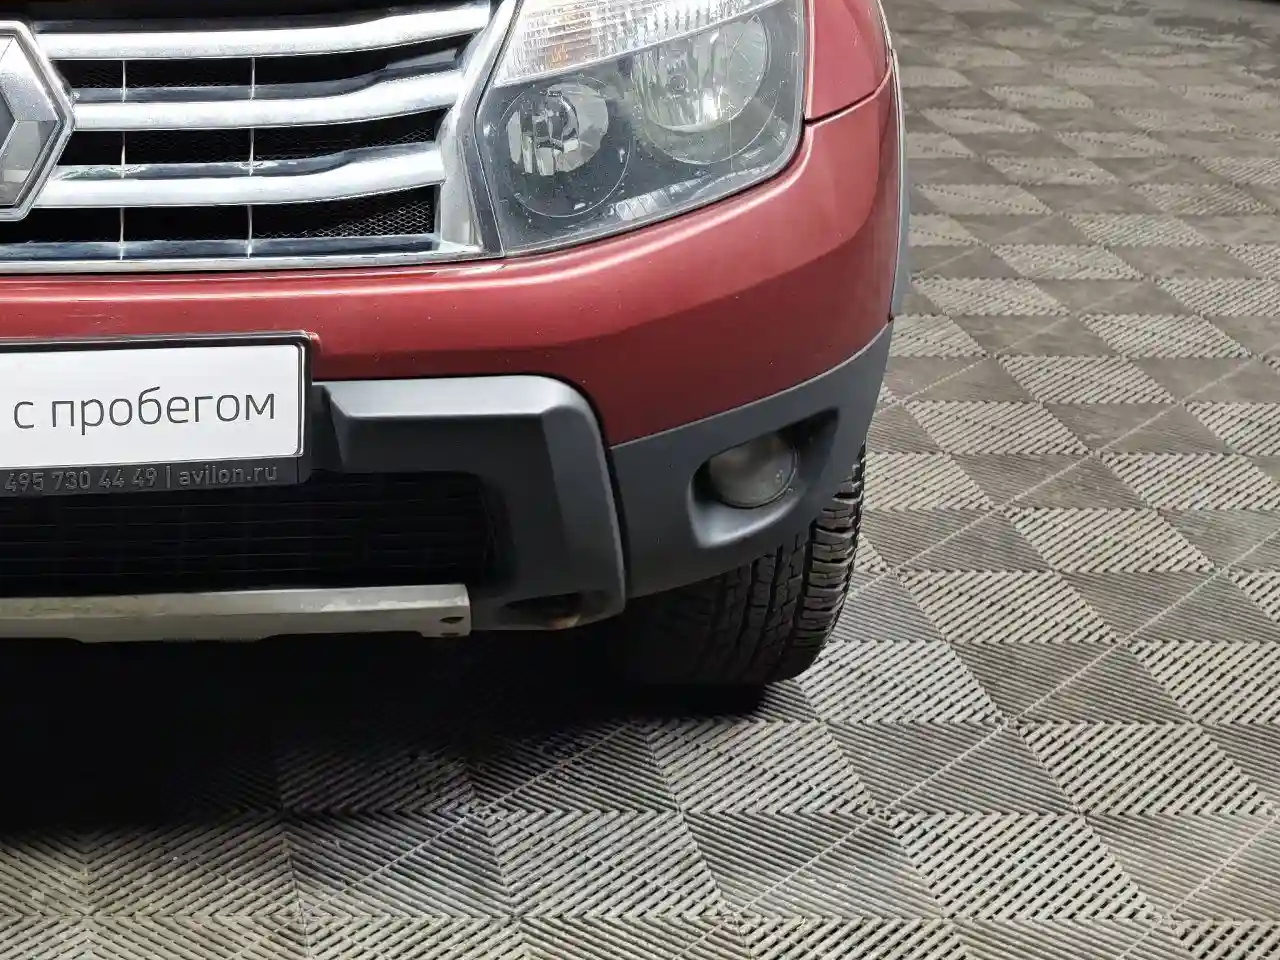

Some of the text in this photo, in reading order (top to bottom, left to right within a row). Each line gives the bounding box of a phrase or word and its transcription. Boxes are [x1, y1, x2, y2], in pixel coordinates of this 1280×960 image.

[14, 400, 35, 429] с
[51, 386, 276, 435] пробегом
[4, 464, 278, 493] 495 730 44 49 avilon.ru
